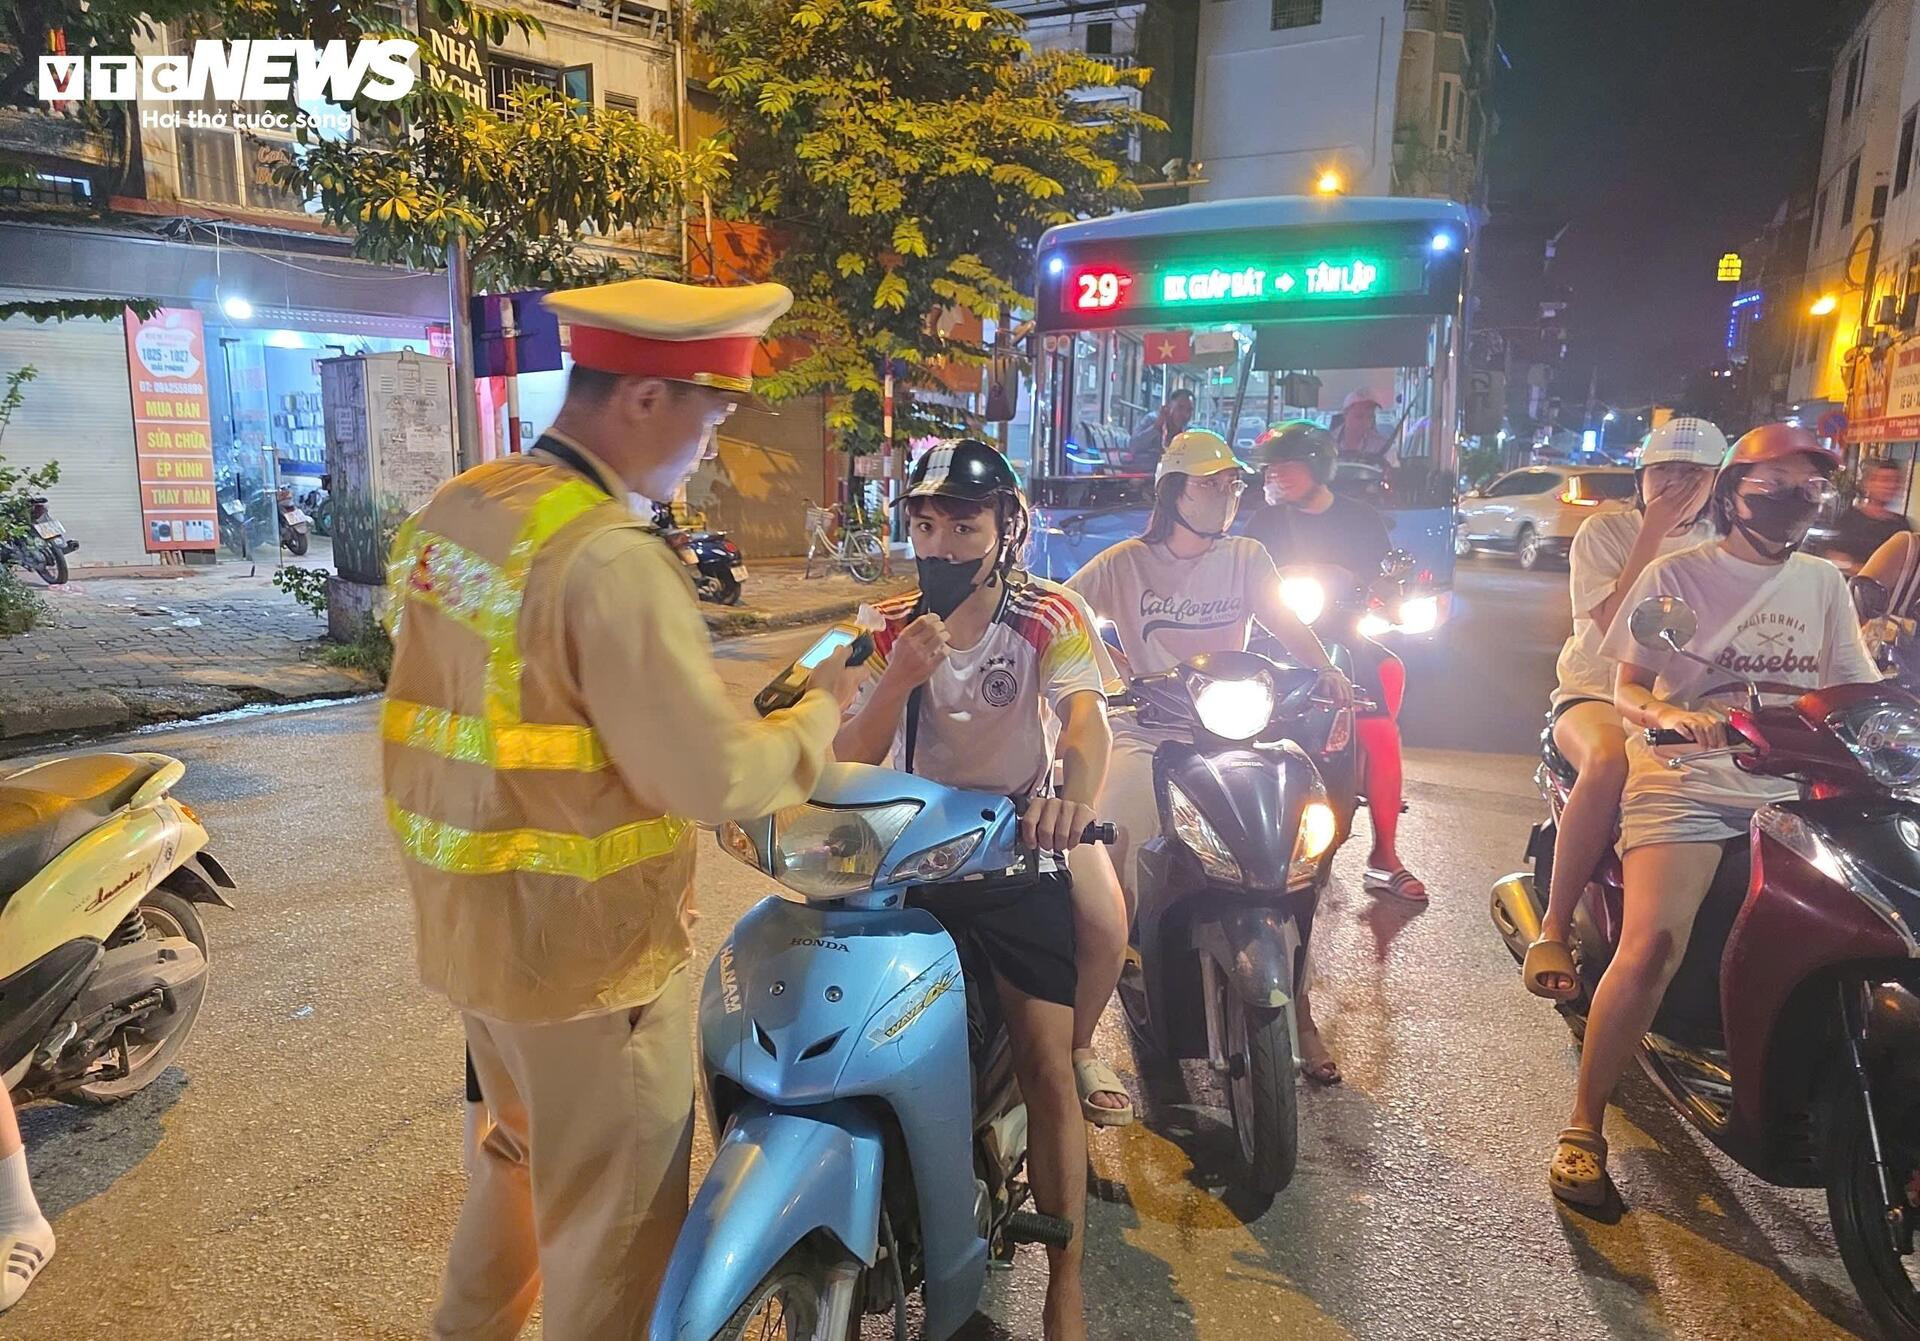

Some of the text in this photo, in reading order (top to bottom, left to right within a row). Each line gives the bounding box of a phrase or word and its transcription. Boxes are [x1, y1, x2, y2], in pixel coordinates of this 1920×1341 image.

[430, 28, 483, 77] NHÀ
[1078, 273, 1119, 308] 29
[146, 400, 200, 418] MUA BÁN
[147, 427, 207, 449] SỬA CHỮA
[156, 459, 204, 478] ÉP KÍNH
[152, 488, 180, 505] THAY
[1141, 589, 1240, 621] California
[1737, 613, 1806, 633] CALIFORNIA
[790, 938, 850, 953] HONDA
